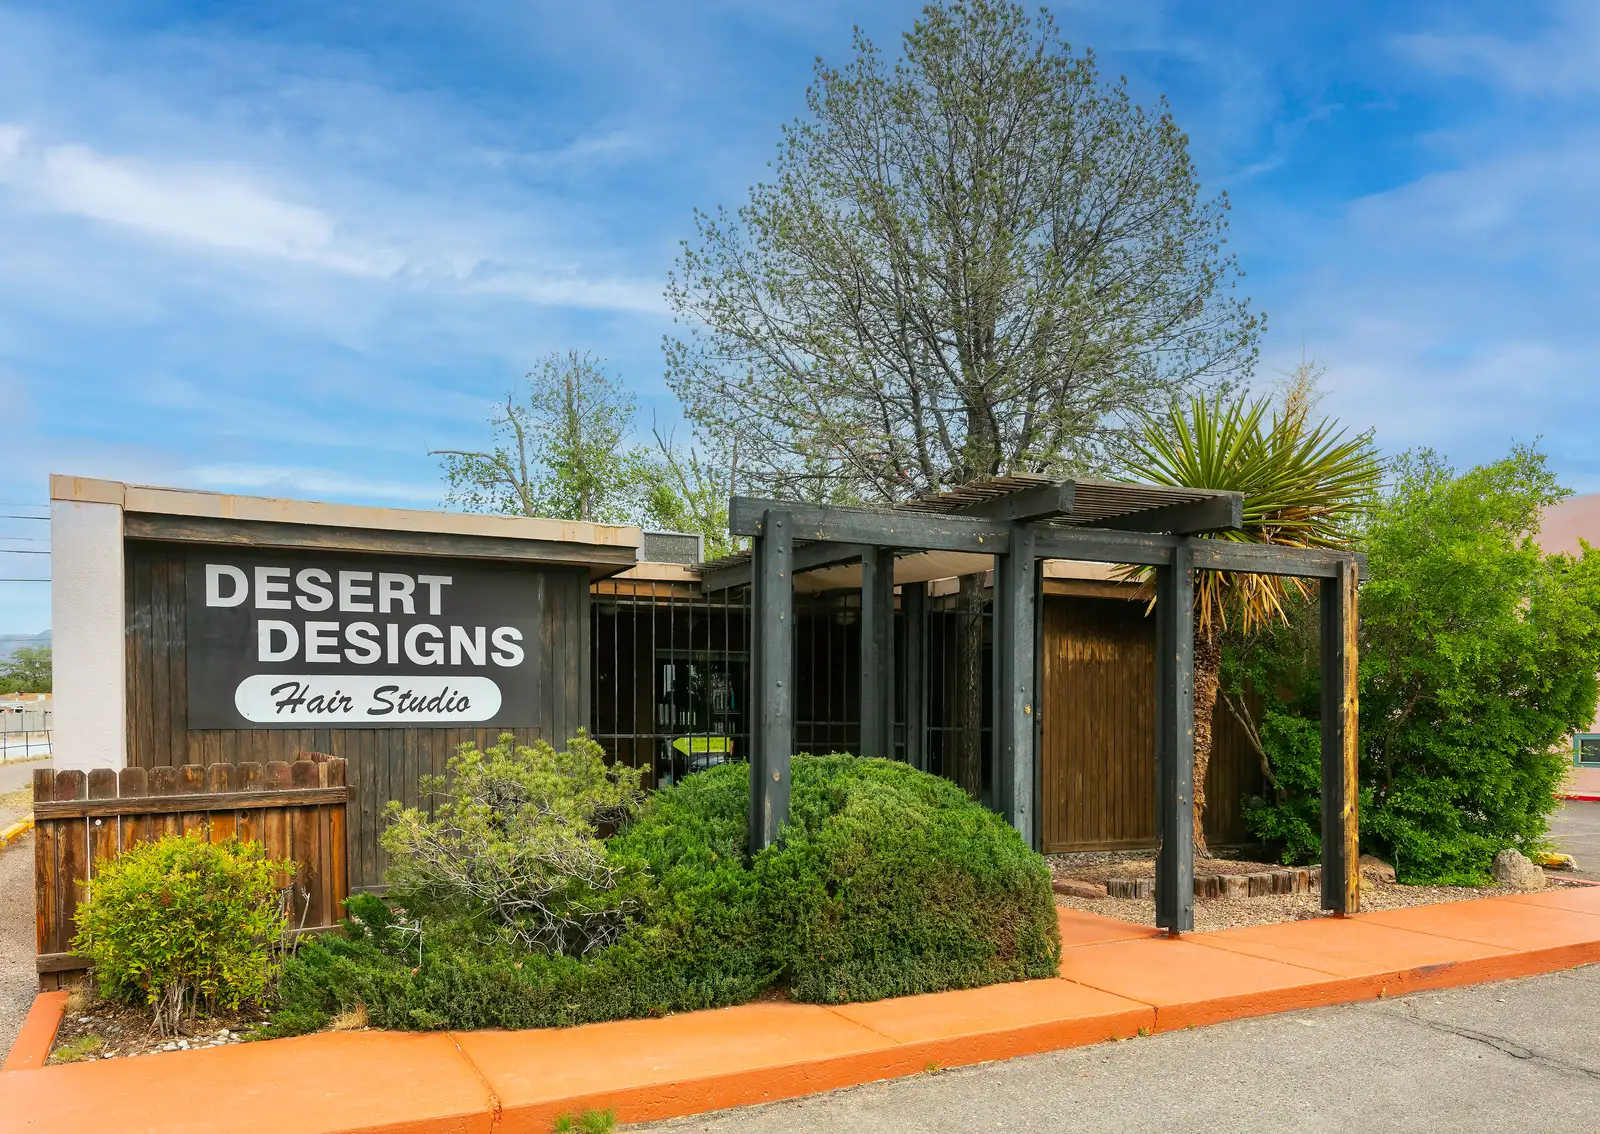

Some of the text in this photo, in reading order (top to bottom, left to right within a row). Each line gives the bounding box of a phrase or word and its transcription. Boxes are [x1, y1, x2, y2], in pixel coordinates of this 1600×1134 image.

[206, 563, 453, 615] DESERT
[257, 620, 525, 667] DESIGNS
[270, 681, 472, 716] Hair Studio
